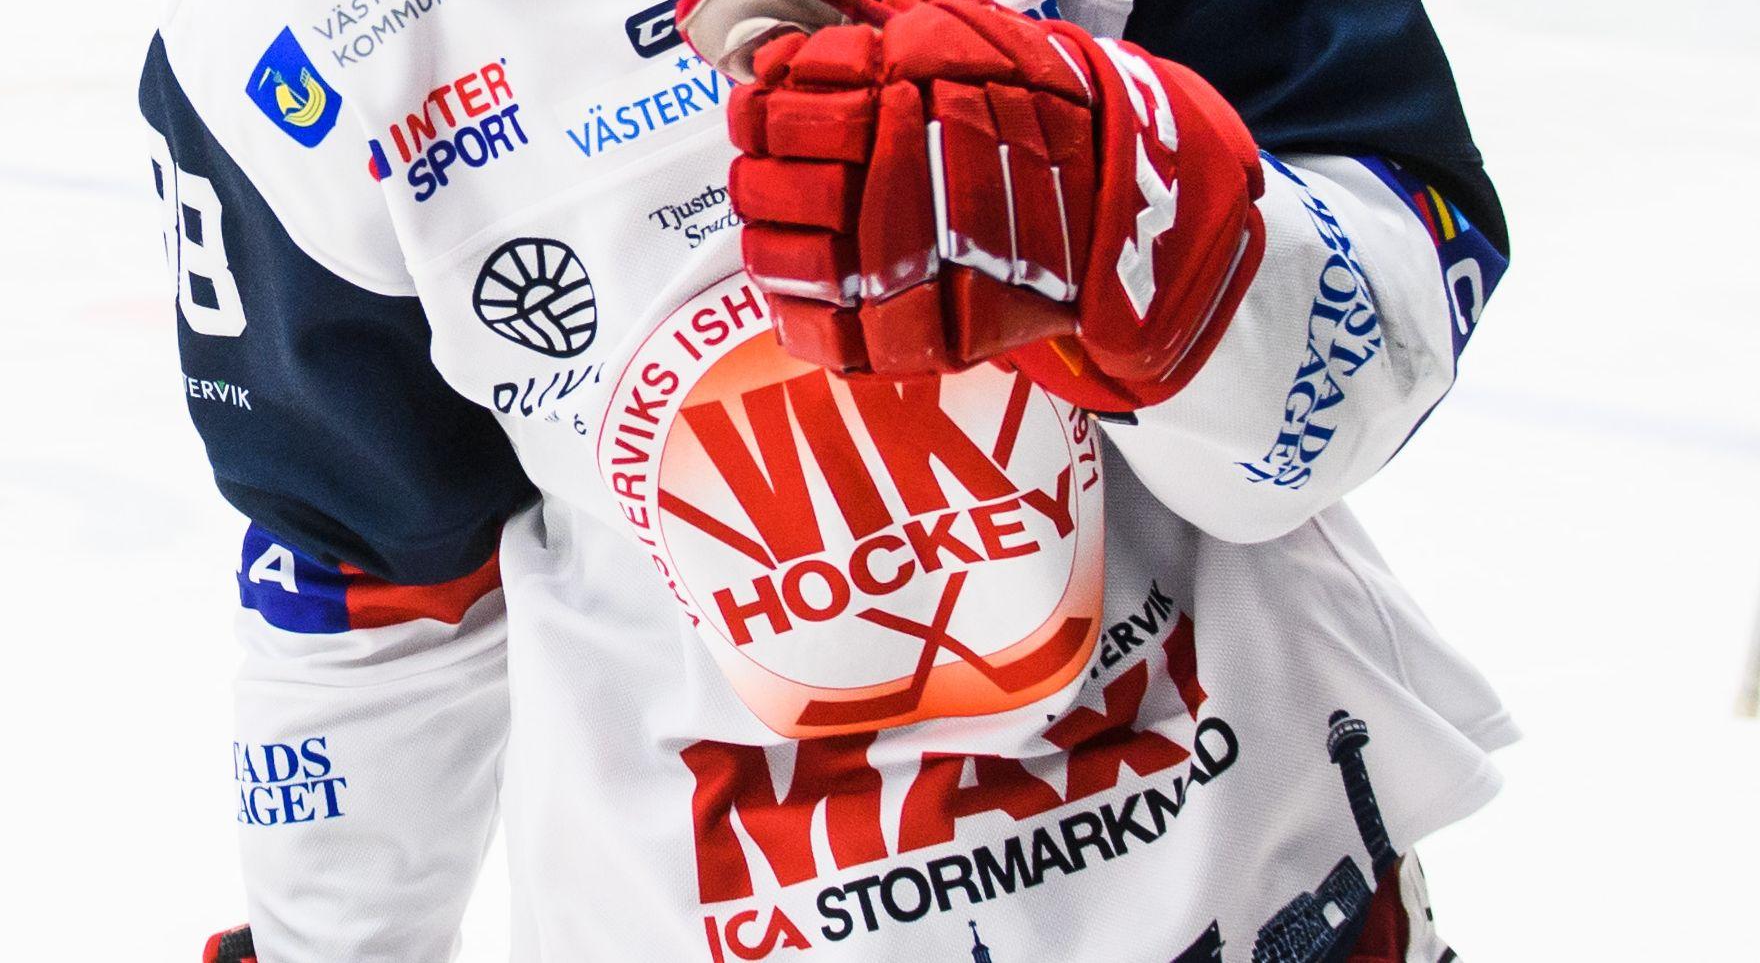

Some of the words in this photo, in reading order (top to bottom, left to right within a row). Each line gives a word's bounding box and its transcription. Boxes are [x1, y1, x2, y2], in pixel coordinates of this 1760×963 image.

[389, 60, 514, 165] INTER
[407, 104, 530, 203] SPORT
[566, 69, 736, 159] VÄSTERV
[673, 285, 764, 362] ISH
[678, 368, 1020, 564] VIK
[712, 464, 1078, 646] HOCKEY
[679, 611, 1209, 905] MAXI
[703, 905, 813, 963] ICA
